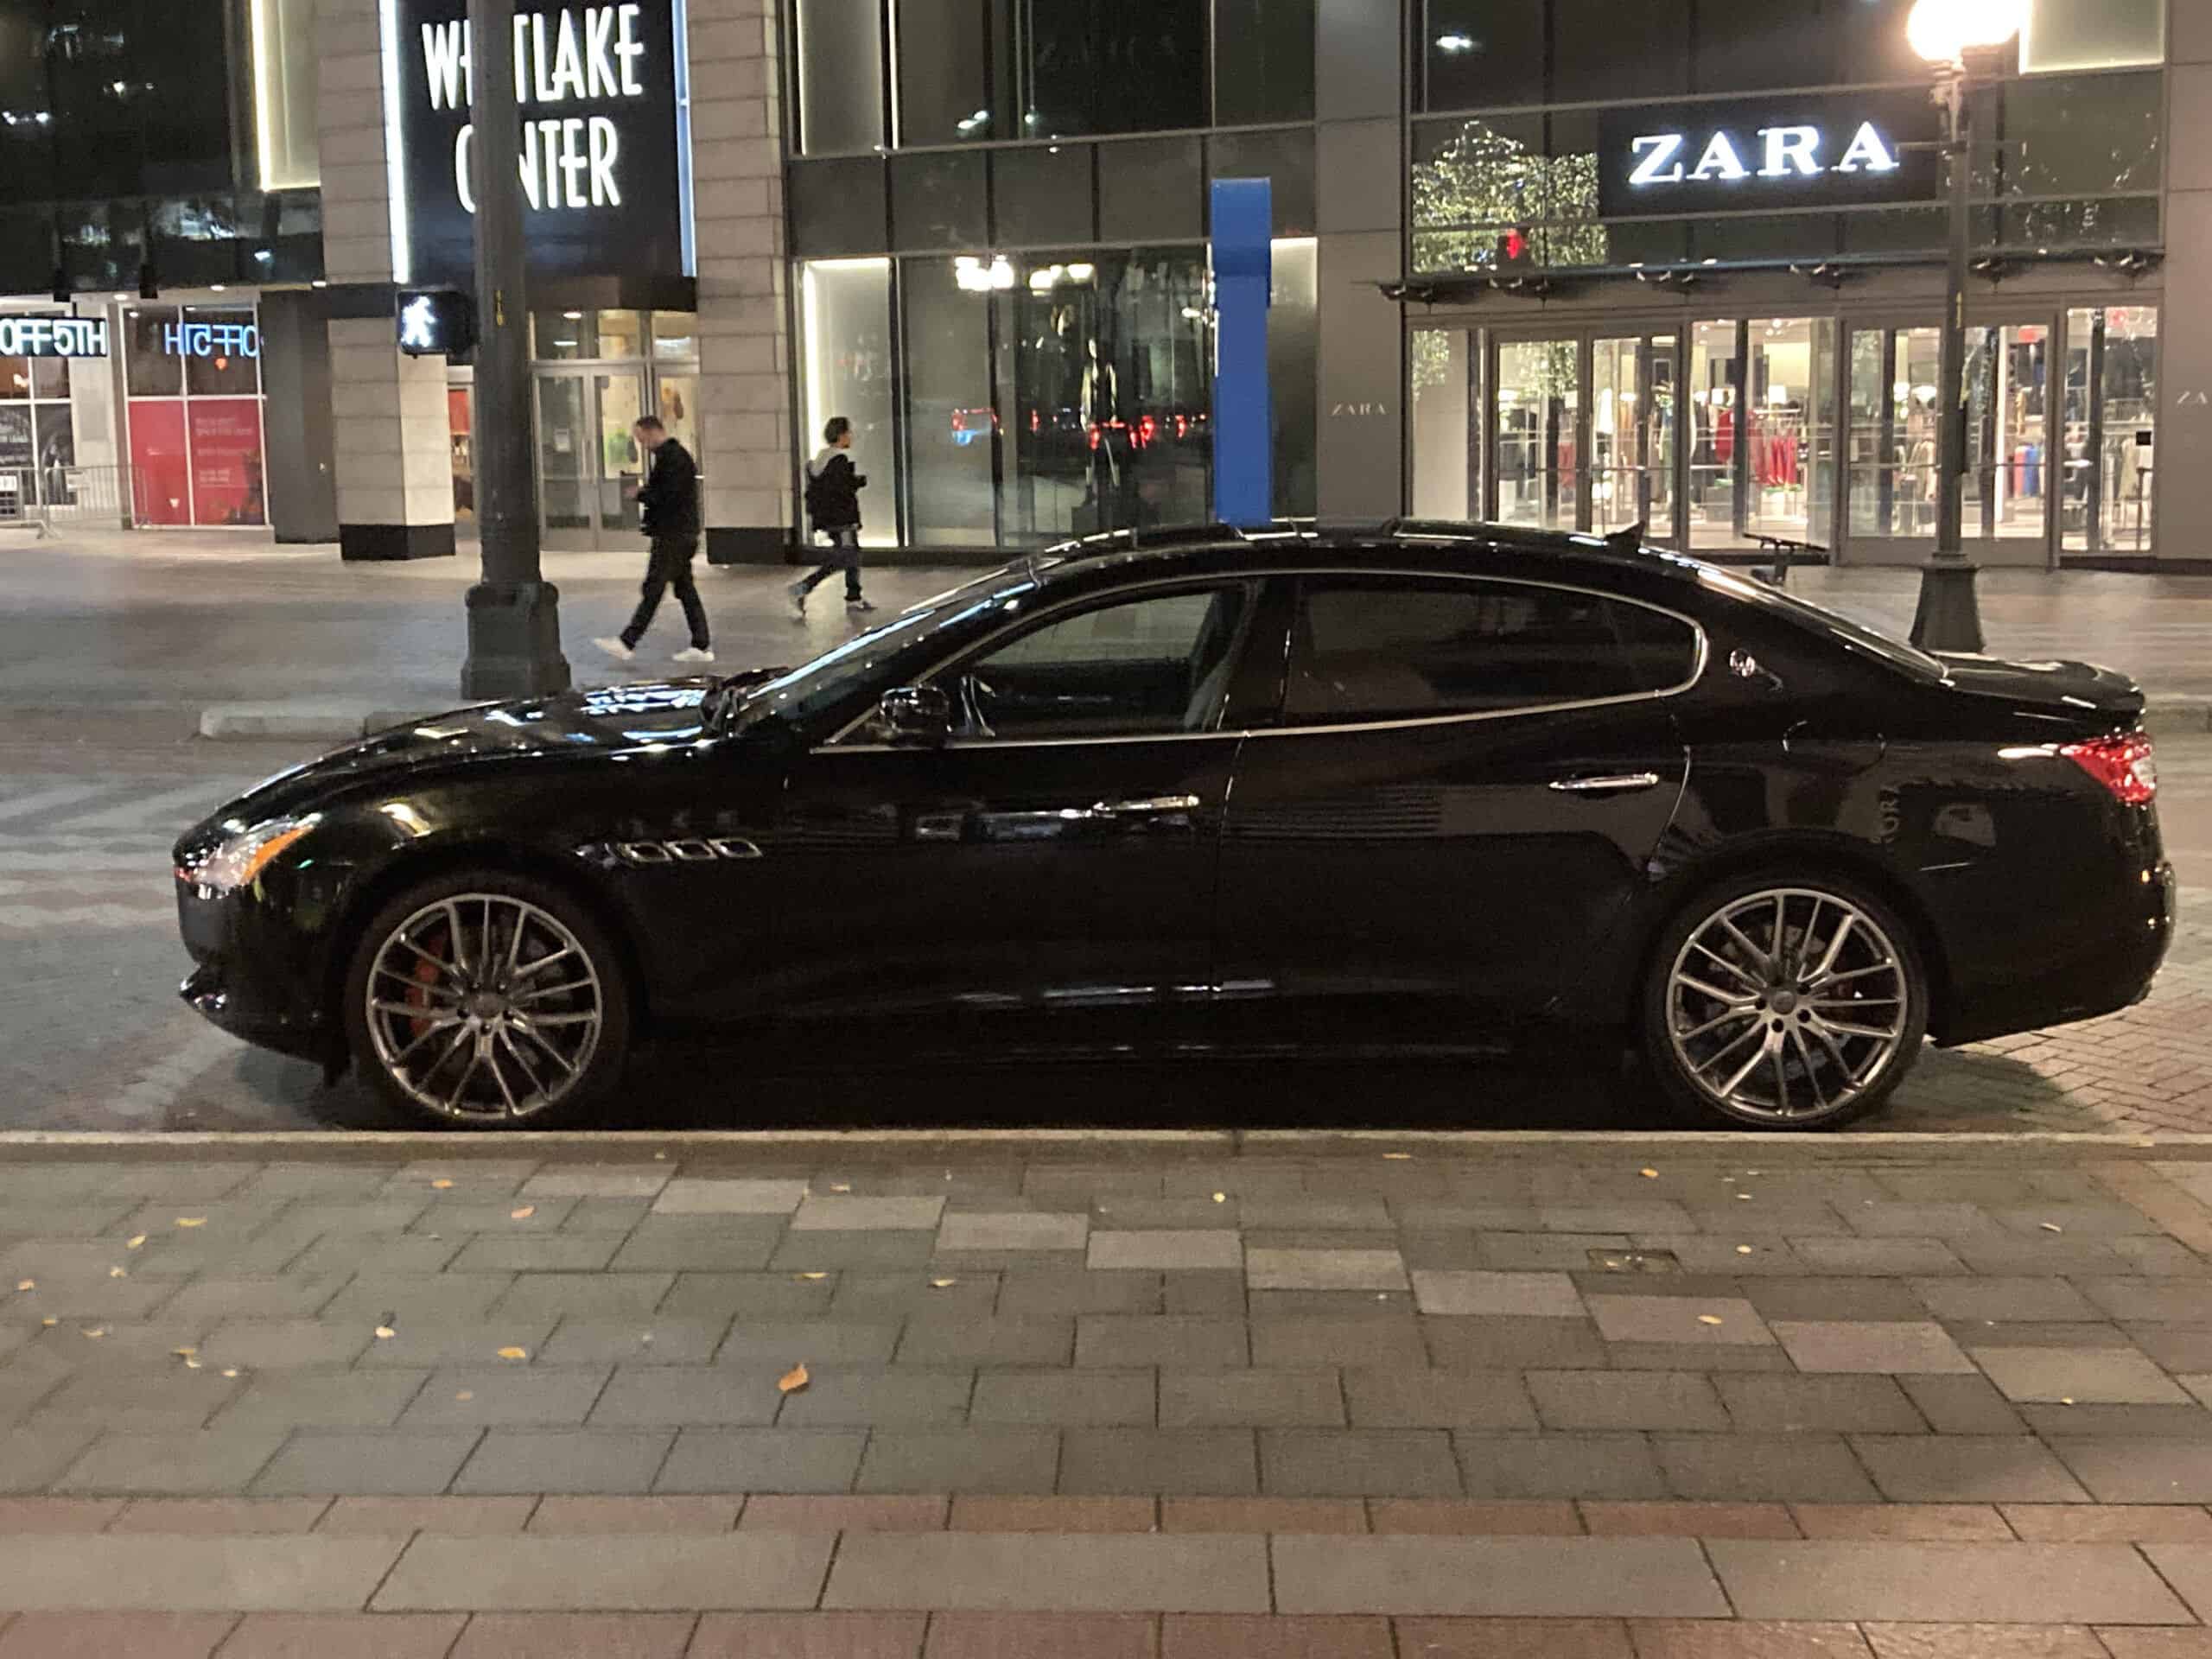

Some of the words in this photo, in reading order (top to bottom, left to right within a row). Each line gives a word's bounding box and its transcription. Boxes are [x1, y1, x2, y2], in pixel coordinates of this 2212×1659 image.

[422, 3, 644, 111] WTLAKE
[455, 117, 621, 213] CNTER
[1629, 121, 1899, 184] ZARA
[0, 318, 52, 355] OFF
[53, 319, 106, 355] 5TH
